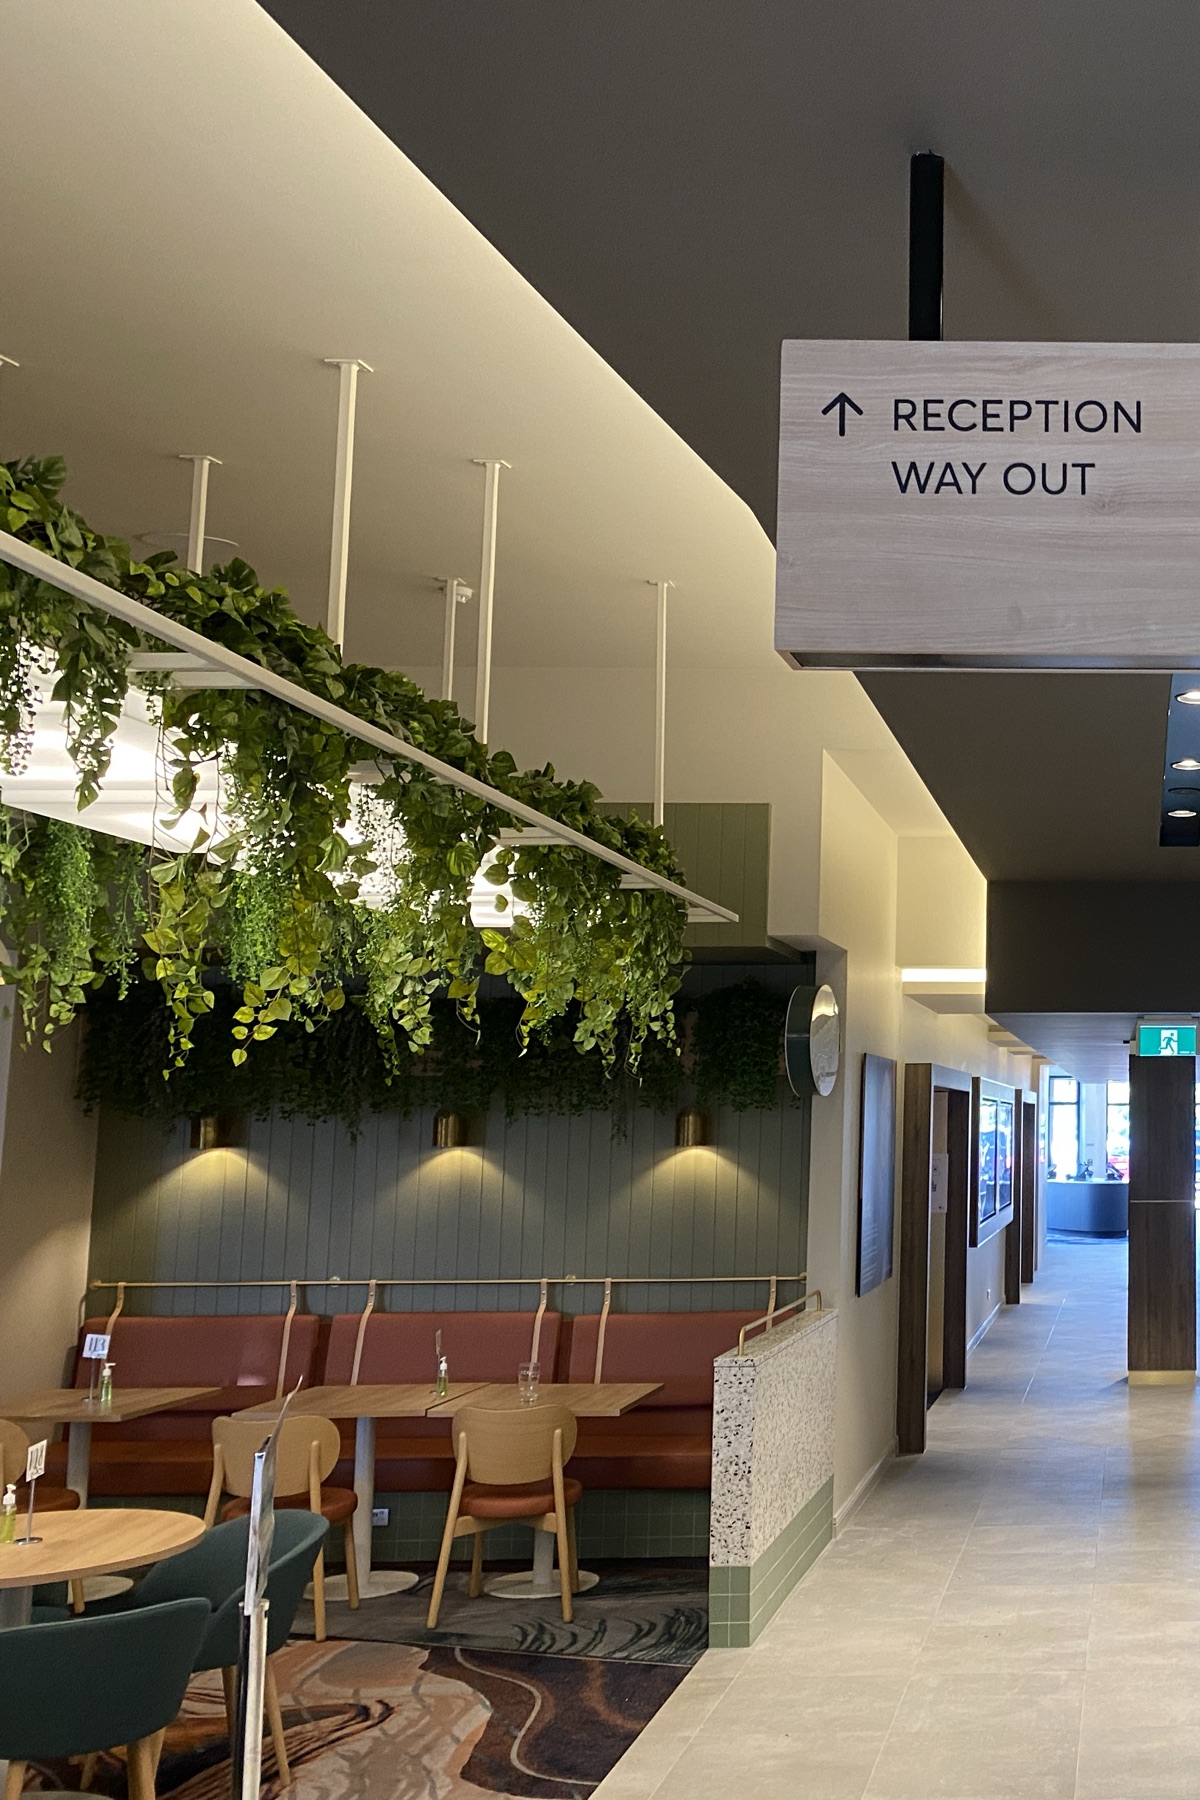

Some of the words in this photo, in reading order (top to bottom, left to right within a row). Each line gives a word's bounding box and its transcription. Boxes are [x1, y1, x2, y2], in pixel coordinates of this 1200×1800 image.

[893, 398, 1142, 434] RECEPTION
[890, 461, 987, 495] WAY
[1003, 462, 1096, 496] OUT
